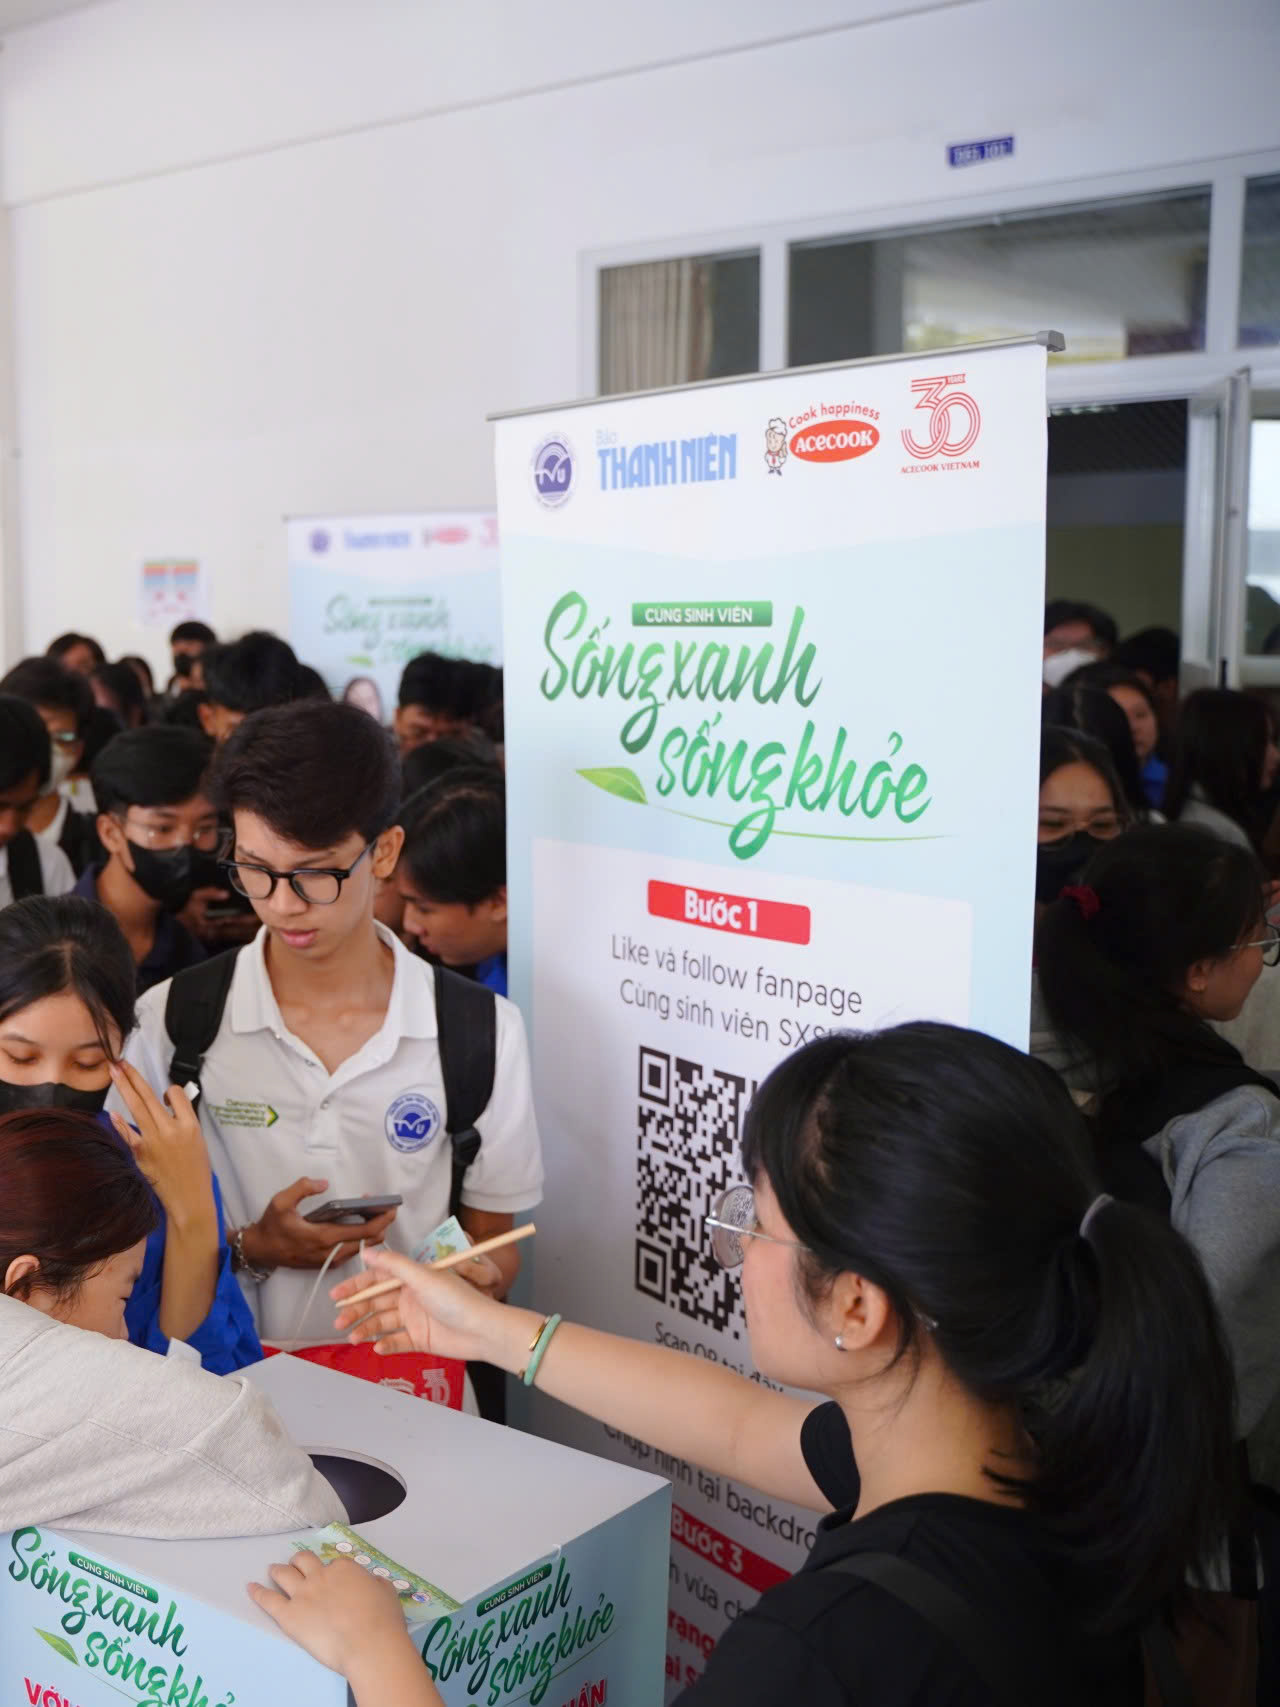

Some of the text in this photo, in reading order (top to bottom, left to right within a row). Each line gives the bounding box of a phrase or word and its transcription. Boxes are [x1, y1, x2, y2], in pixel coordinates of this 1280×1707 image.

[788, 400, 881, 430] Cook happiness
[597, 440, 677, 491] THANH
[901, 460, 980, 473] ACECOOK VIETNAM
[684, 607, 714, 623] SINH
[539, 591, 823, 754] Sống xanh
[656, 712, 933, 860] sống khỏe
[684, 888, 758, 932] Bước 1
[611, 934, 863, 1017] Like và follow fanpage
[620, 979, 670, 1021] Cùng
[676, 995, 714, 1029] sinh
[721, 1009, 769, 1042] viên
[656, 1321, 690, 1353] Scan
[726, 1484, 817, 1551] backdro
[104, 1569, 125, 1587] SINH
[729, 1543, 743, 1574] 3
[8, 1526, 189, 1657] Sống xanh
[495, 1557, 573, 1649] xanh
[507, 1580, 525, 1598] SINH
